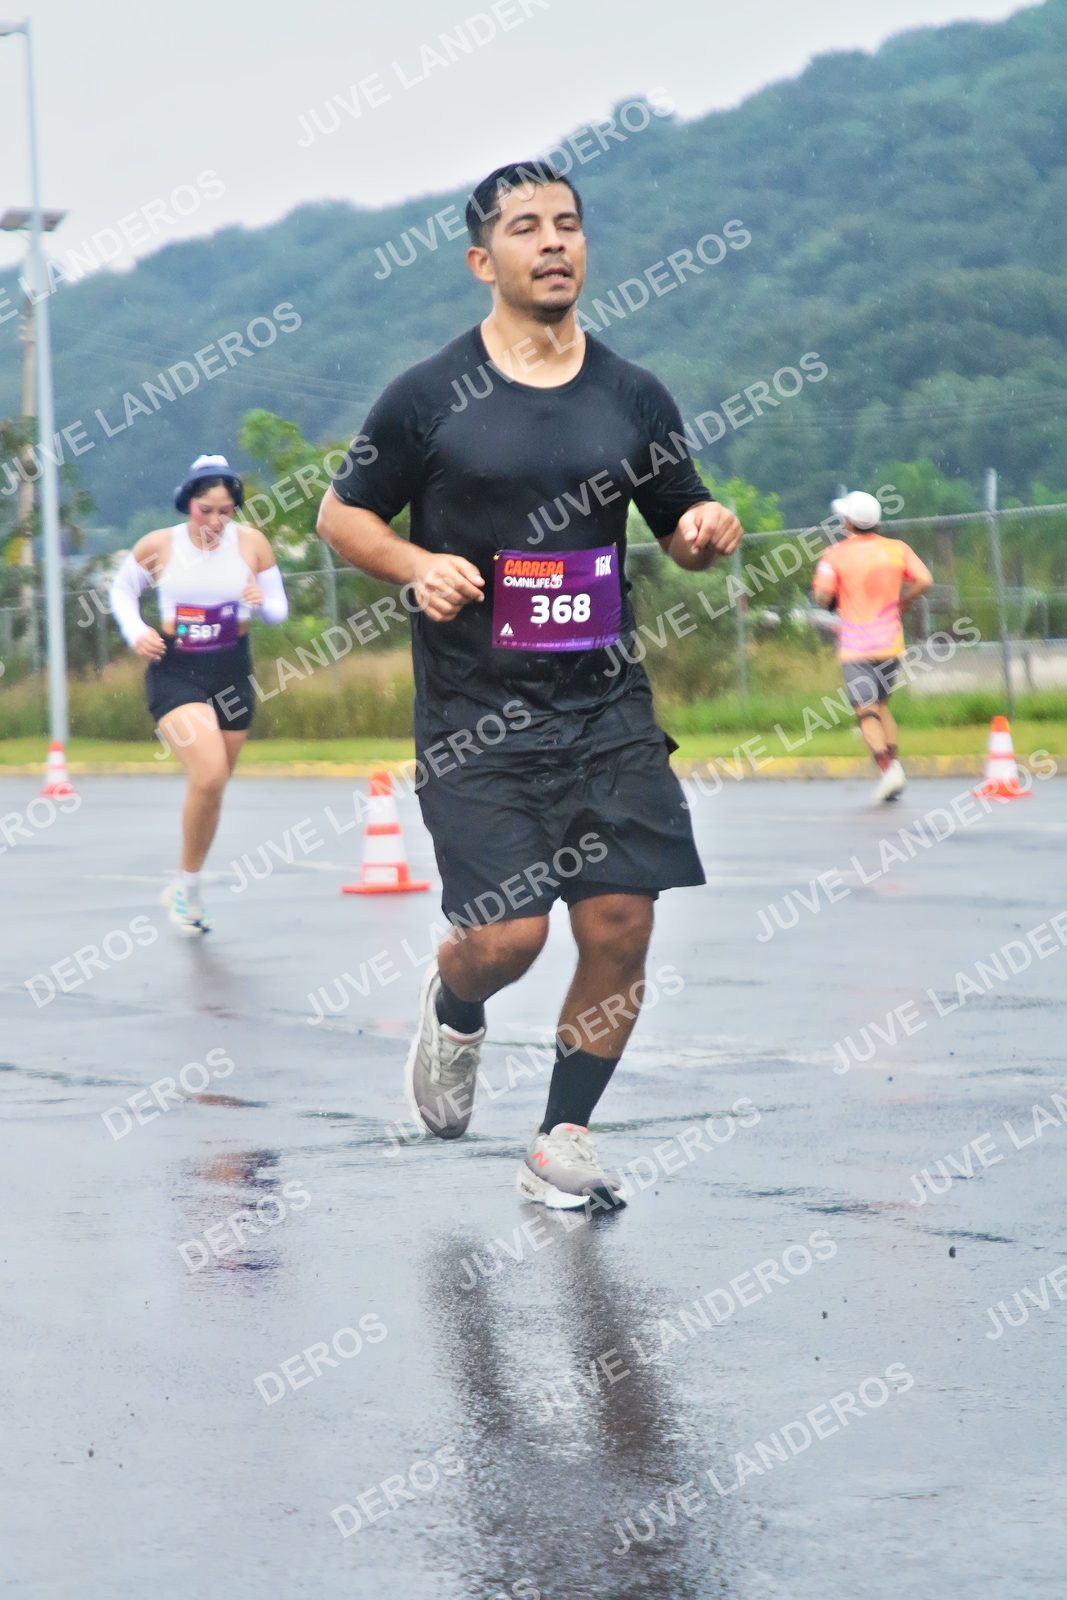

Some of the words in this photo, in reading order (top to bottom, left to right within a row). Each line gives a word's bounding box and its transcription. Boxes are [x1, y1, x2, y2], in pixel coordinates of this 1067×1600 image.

[504, 559, 564, 577] CARRERA
[530, 593, 591, 624] 368
[189, 623, 222, 641] 587
